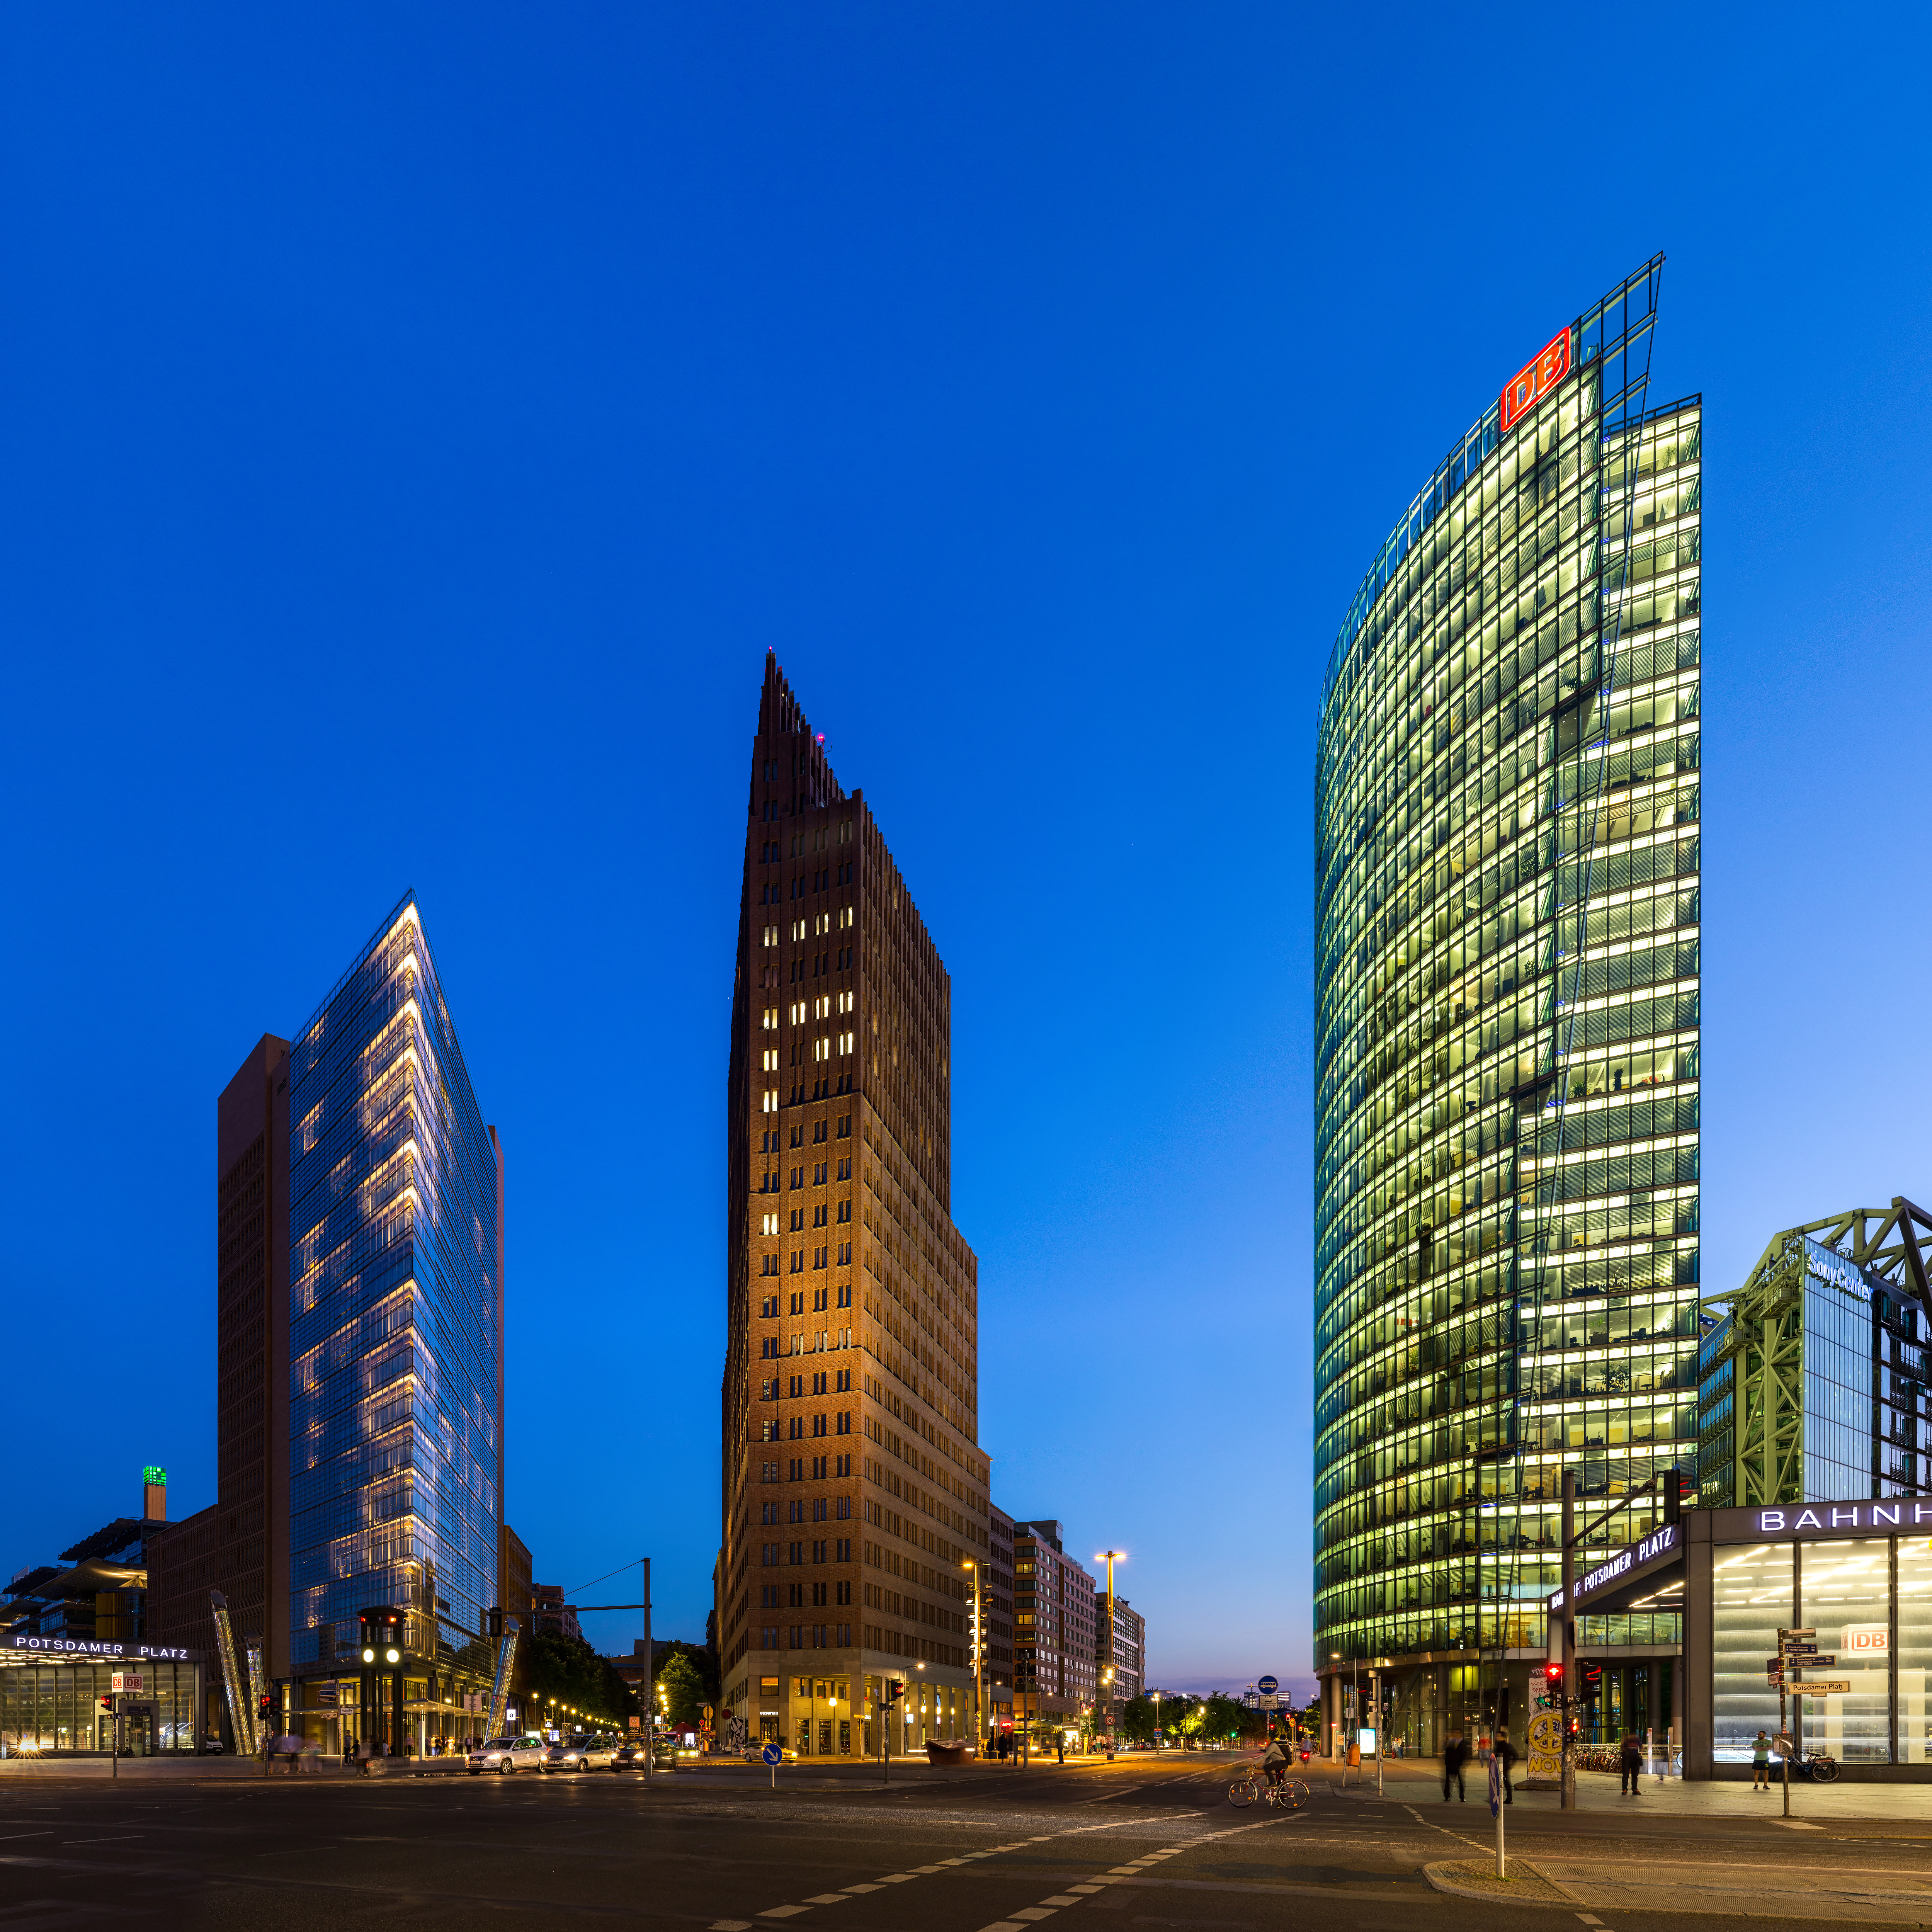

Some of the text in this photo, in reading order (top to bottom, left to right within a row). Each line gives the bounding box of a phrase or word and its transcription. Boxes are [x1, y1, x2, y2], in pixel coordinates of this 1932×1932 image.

[1510, 345, 1563, 420] DB
[1809, 1251, 1874, 1302] Sony Center
[1761, 1503, 1932, 1531] BAHNH
[1585, 1552, 1632, 1591] POTSDAMER
[1639, 1527, 1672, 1561] PLATZ
[17, 1637, 187, 1658] POTSDAMER PLATZ
[1857, 1633, 1885, 1648] DB
[114, 1678, 122, 1687] DB
[126, 1678, 140, 1687] DB
[1612, 1716, 1618, 1725] 2
